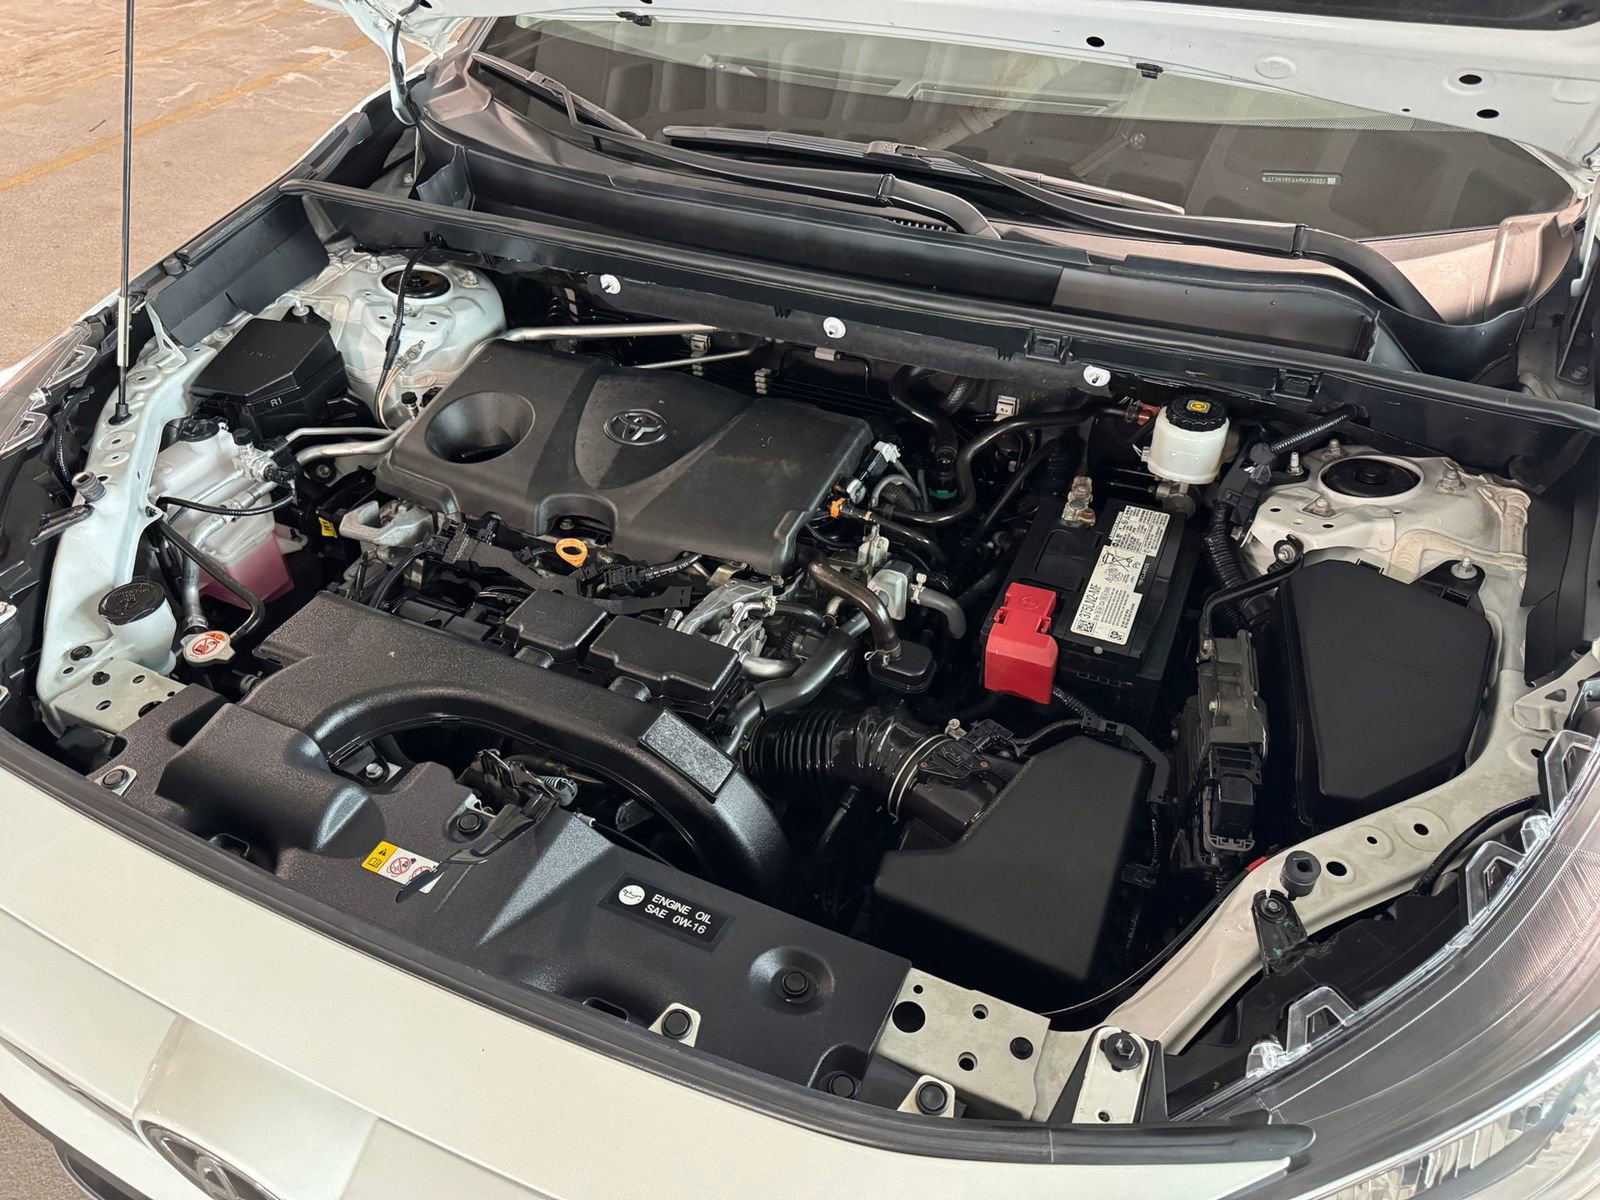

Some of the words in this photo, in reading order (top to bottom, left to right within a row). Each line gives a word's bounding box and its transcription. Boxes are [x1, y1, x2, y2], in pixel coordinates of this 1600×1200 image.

[270, 397, 283, 407] R1
[644, 904, 669, 919] SAE
[672, 915, 707, 934] 0W-16
[651, 894, 692, 915] ENGINE
[695, 911, 712, 925] OIL
